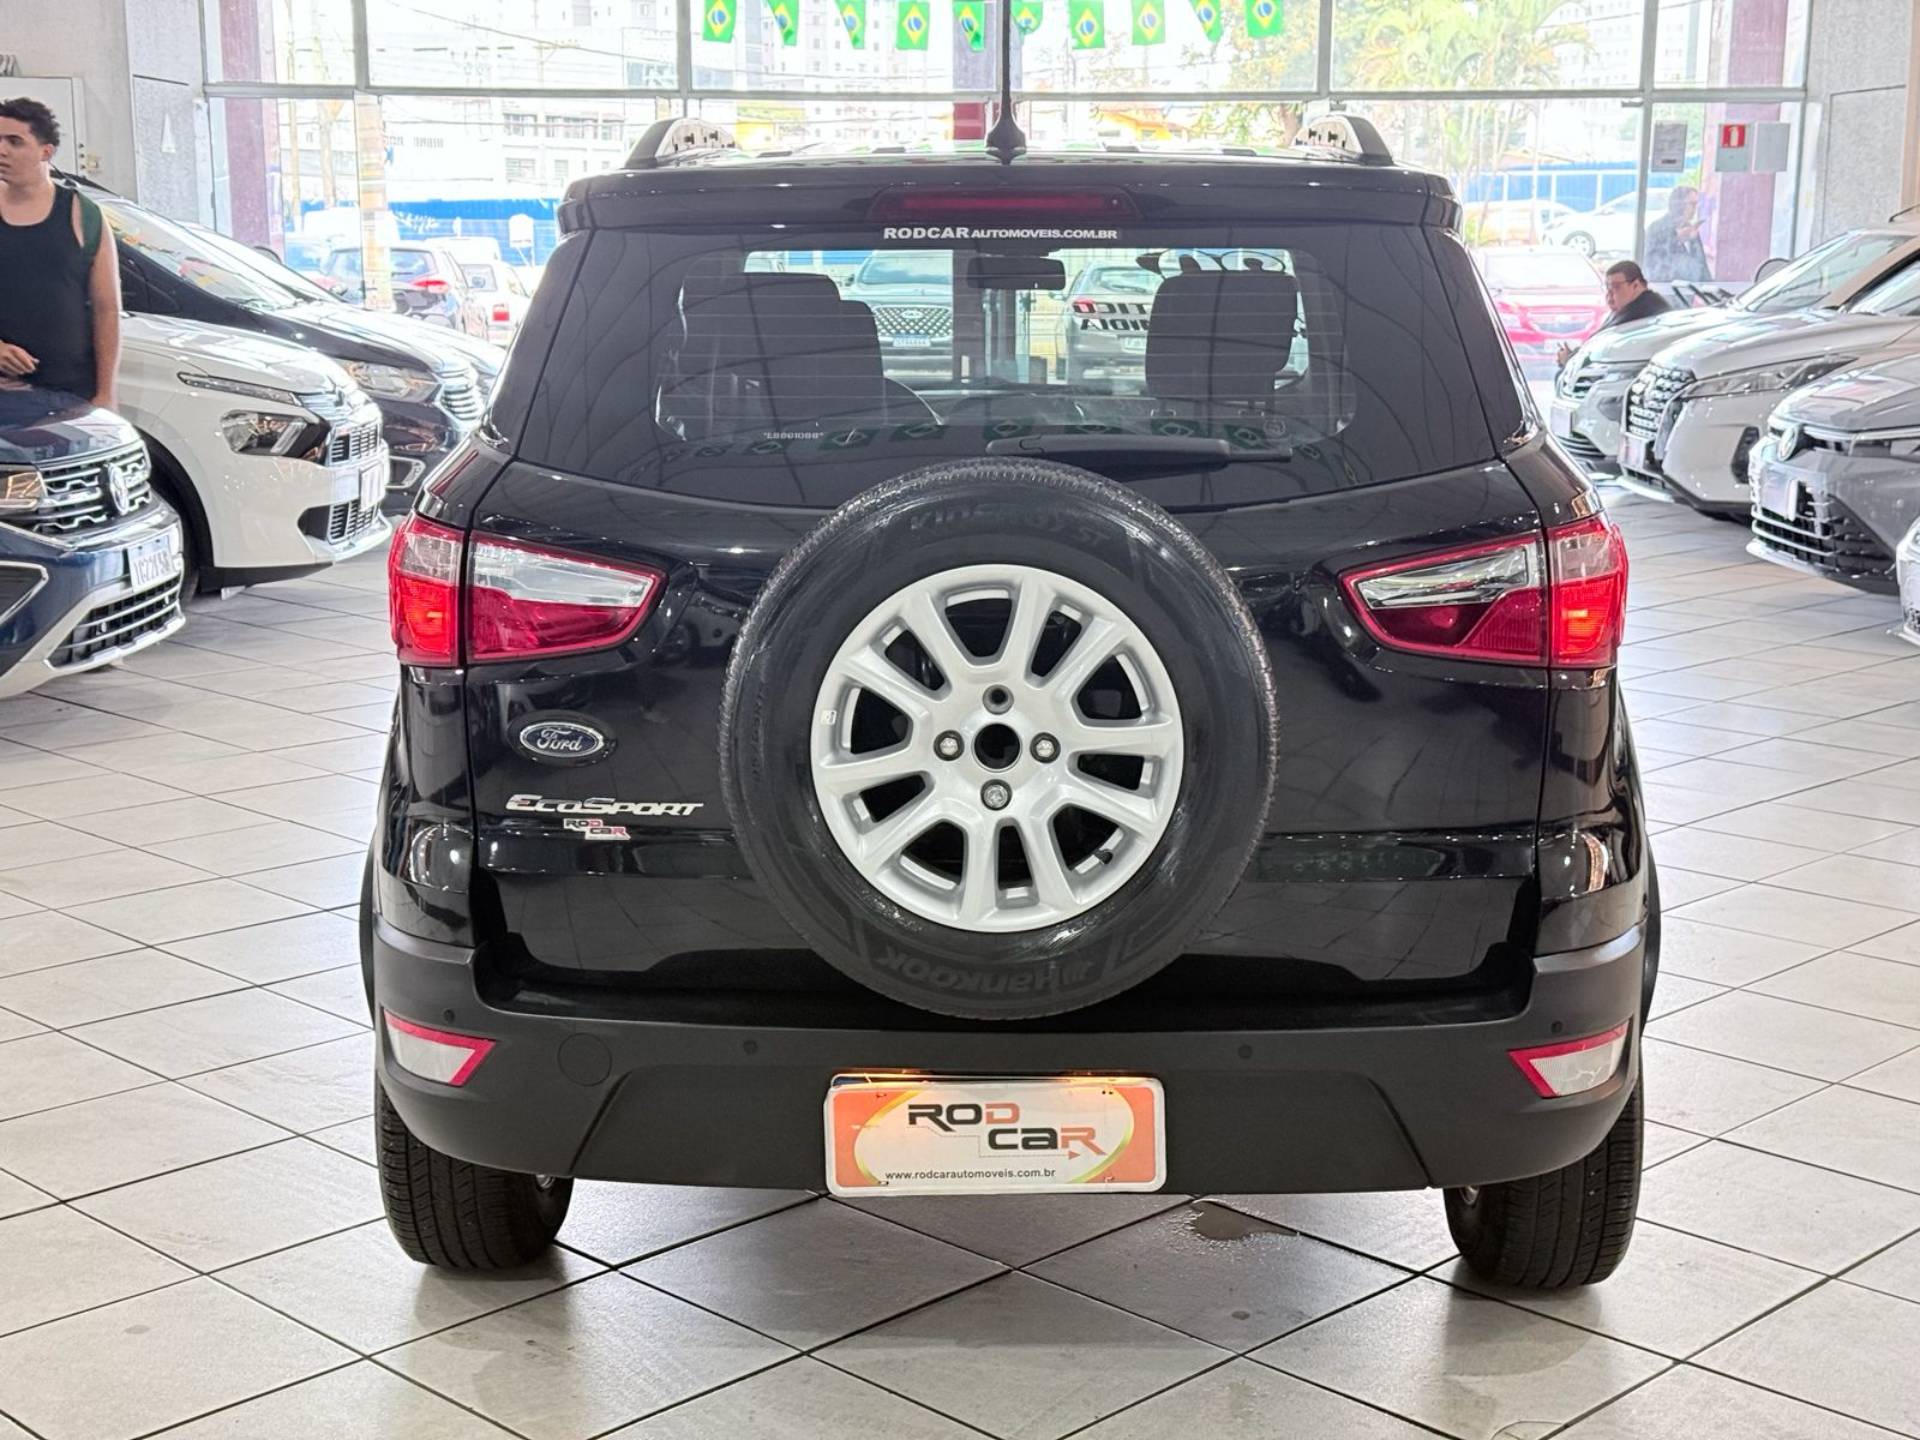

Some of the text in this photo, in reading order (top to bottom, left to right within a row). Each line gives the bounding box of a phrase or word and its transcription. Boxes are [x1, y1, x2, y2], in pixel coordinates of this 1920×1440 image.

[883, 227, 1118, 240] RODCAR AUTOMOVEIS.COM.BR
[536, 728, 584, 751] Ford
[565, 819, 602, 828] ROD
[908, 1102, 1020, 1132] ROD
[885, 1167, 1056, 1180] www.rodcarautomoveis.com.br
